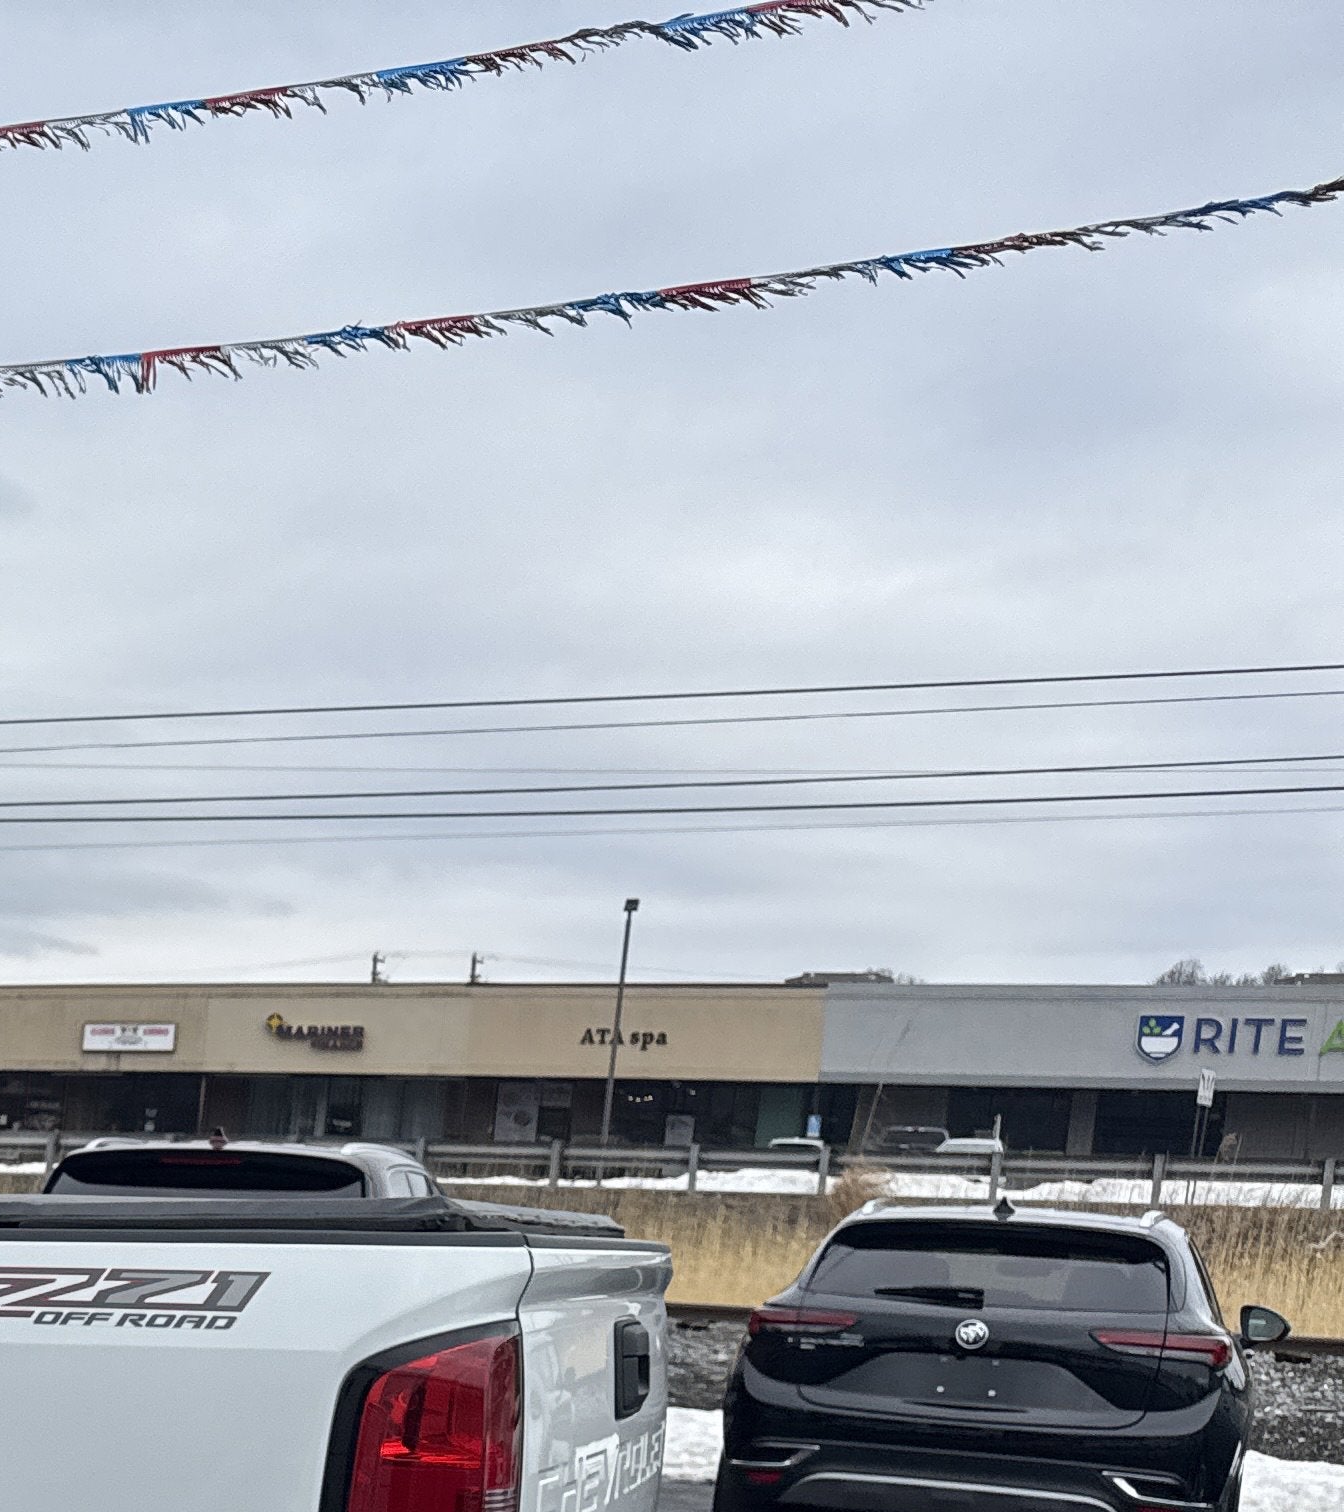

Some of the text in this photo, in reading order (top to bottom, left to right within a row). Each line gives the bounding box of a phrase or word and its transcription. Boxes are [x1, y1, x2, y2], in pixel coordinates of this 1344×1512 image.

[275, 1025, 364, 1040] MARINER
[580, 1027, 668, 1051] ATA spa
[1194, 1017, 1307, 1056] RITE
[33, 1311, 238, 1330] OFF ROAD
